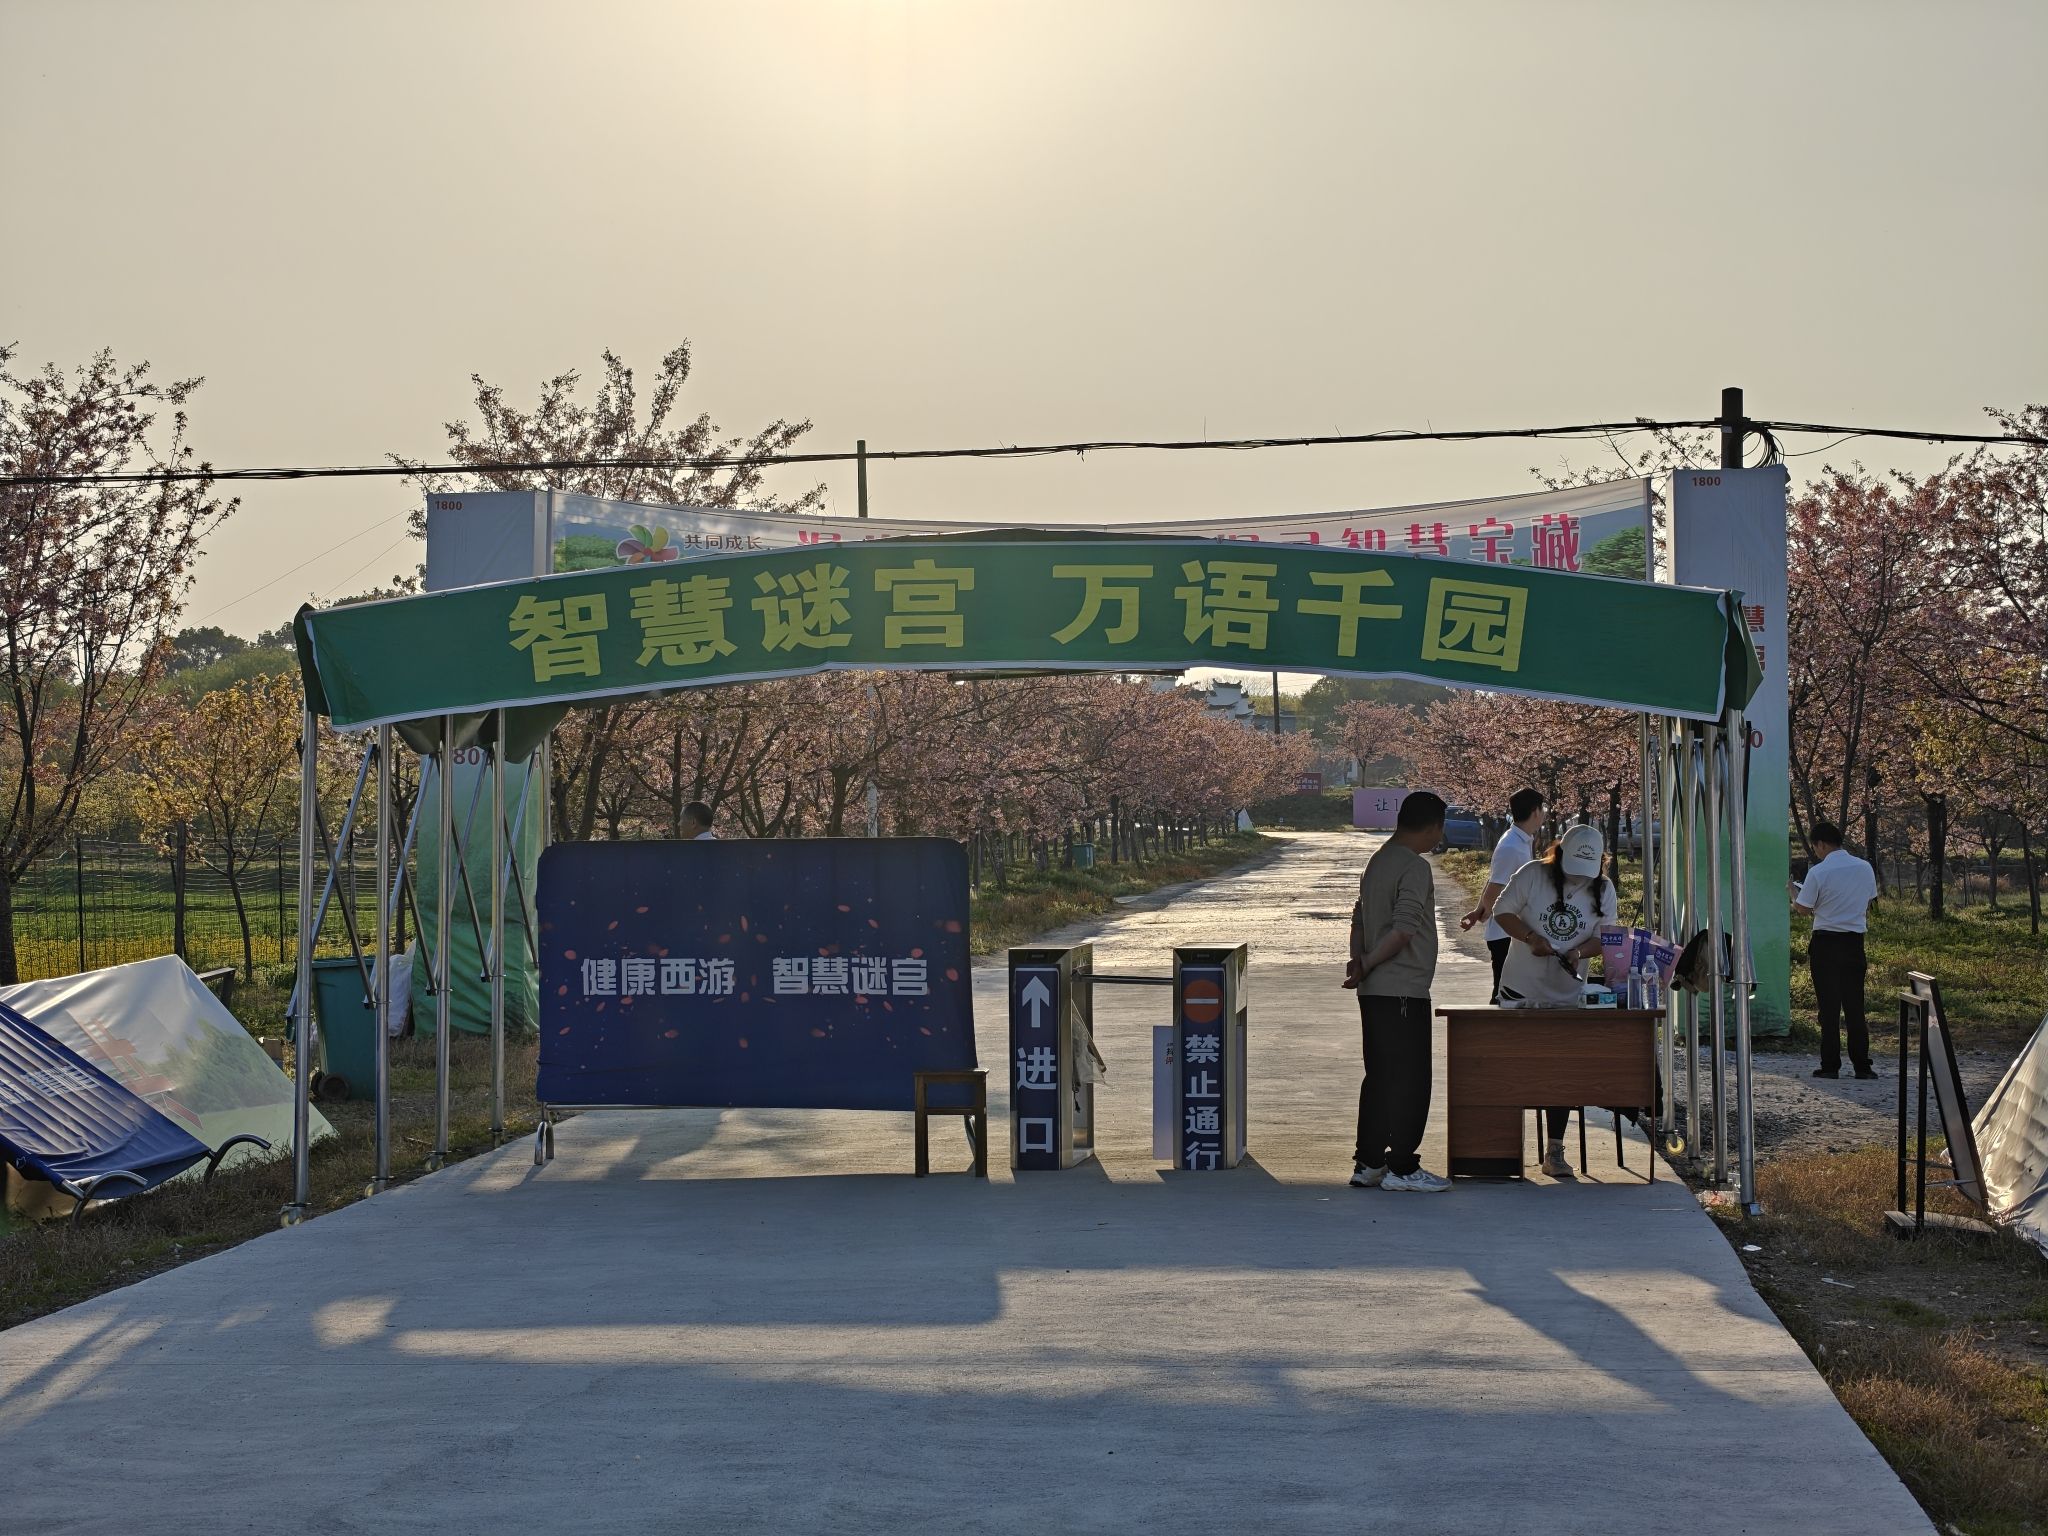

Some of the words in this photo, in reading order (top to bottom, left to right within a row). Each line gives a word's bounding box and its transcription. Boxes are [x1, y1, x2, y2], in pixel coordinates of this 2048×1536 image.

[1692, 476, 1721, 487] 1800
[435, 500, 463, 511] 1800
[684, 534, 763, 550] 共同成长
[508, 559, 975, 682] 智慧谜宫
[1050, 560, 1528, 672] 万语千园
[1546, 903, 1583, 919] CHPIONS
[581, 957, 735, 996] 健康西游
[772, 956, 928, 996] 智慧谜宫
[1016, 1046, 1057, 1154] 进口
[1185, 1033, 1222, 1170] 禁止通行
